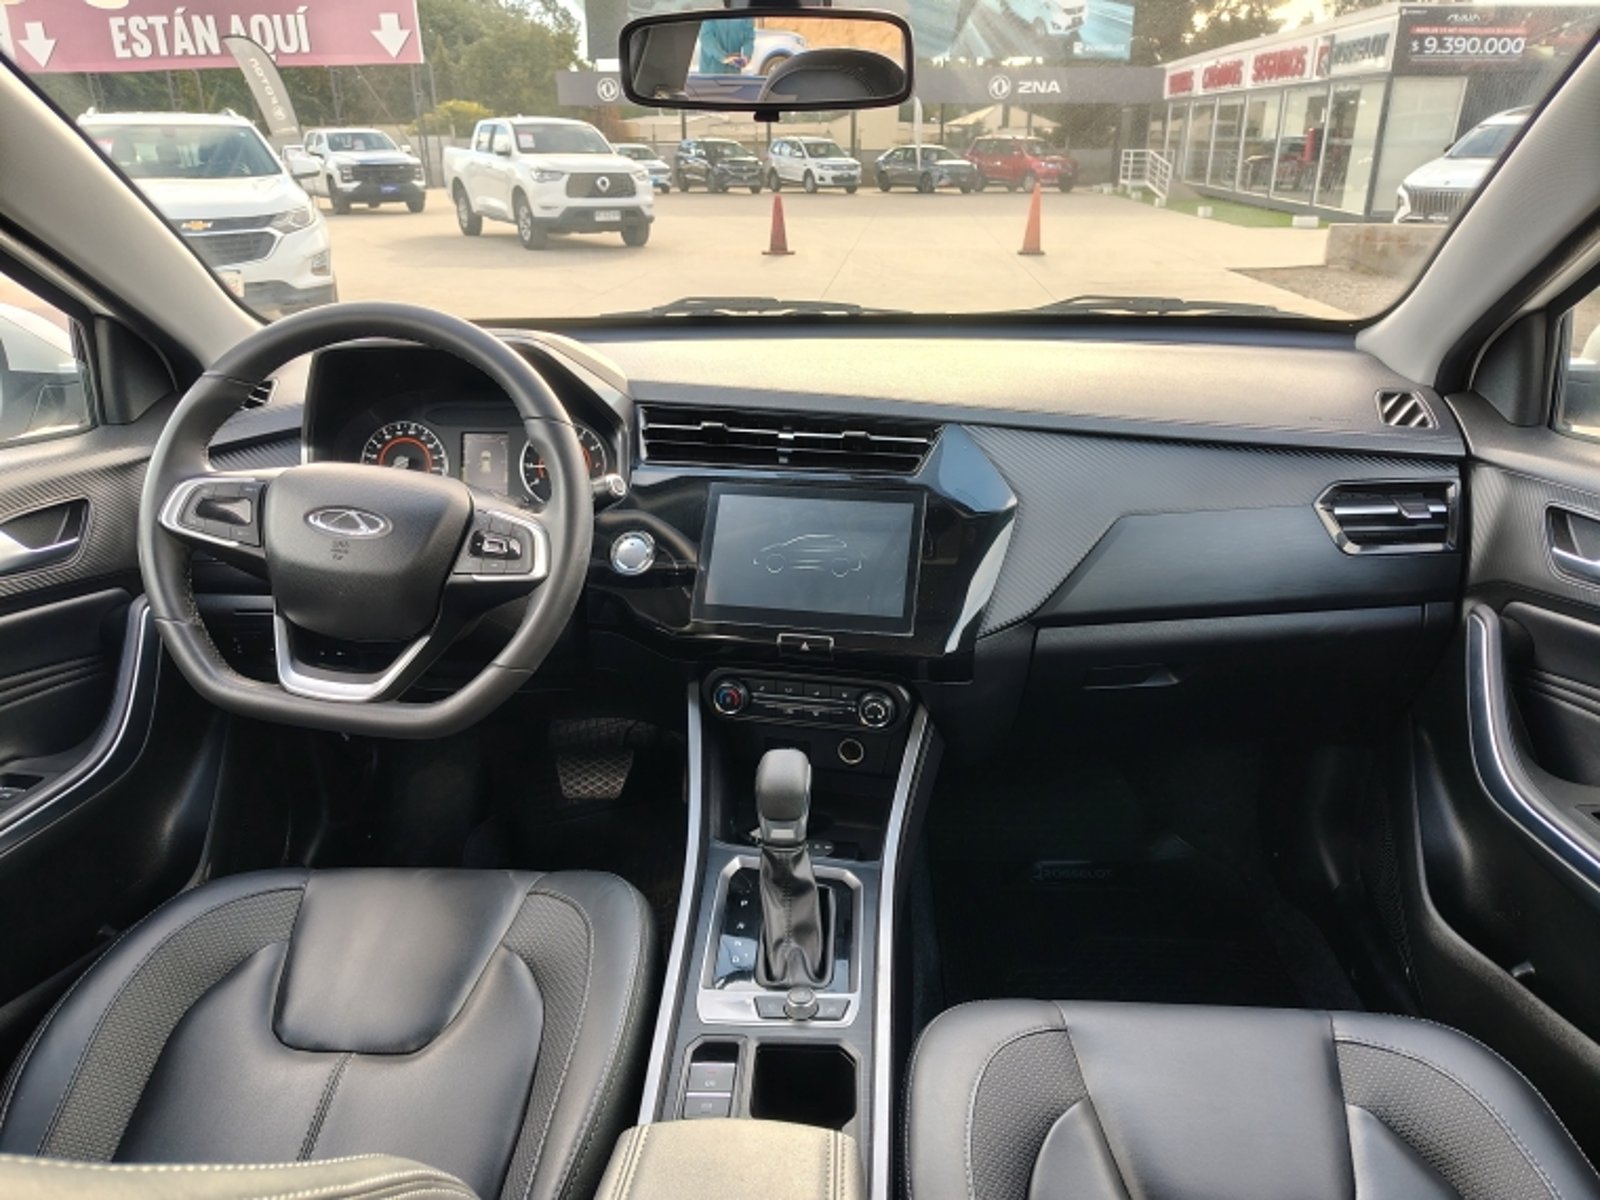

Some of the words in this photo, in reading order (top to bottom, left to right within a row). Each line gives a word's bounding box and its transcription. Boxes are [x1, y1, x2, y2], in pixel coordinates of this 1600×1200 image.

[109, 7, 221, 58] ESTÁN
[1411, 40, 1419, 52] $
[1424, 36, 1526, 54] 9.390.000
[1018, 79, 1061, 94] ZNA
